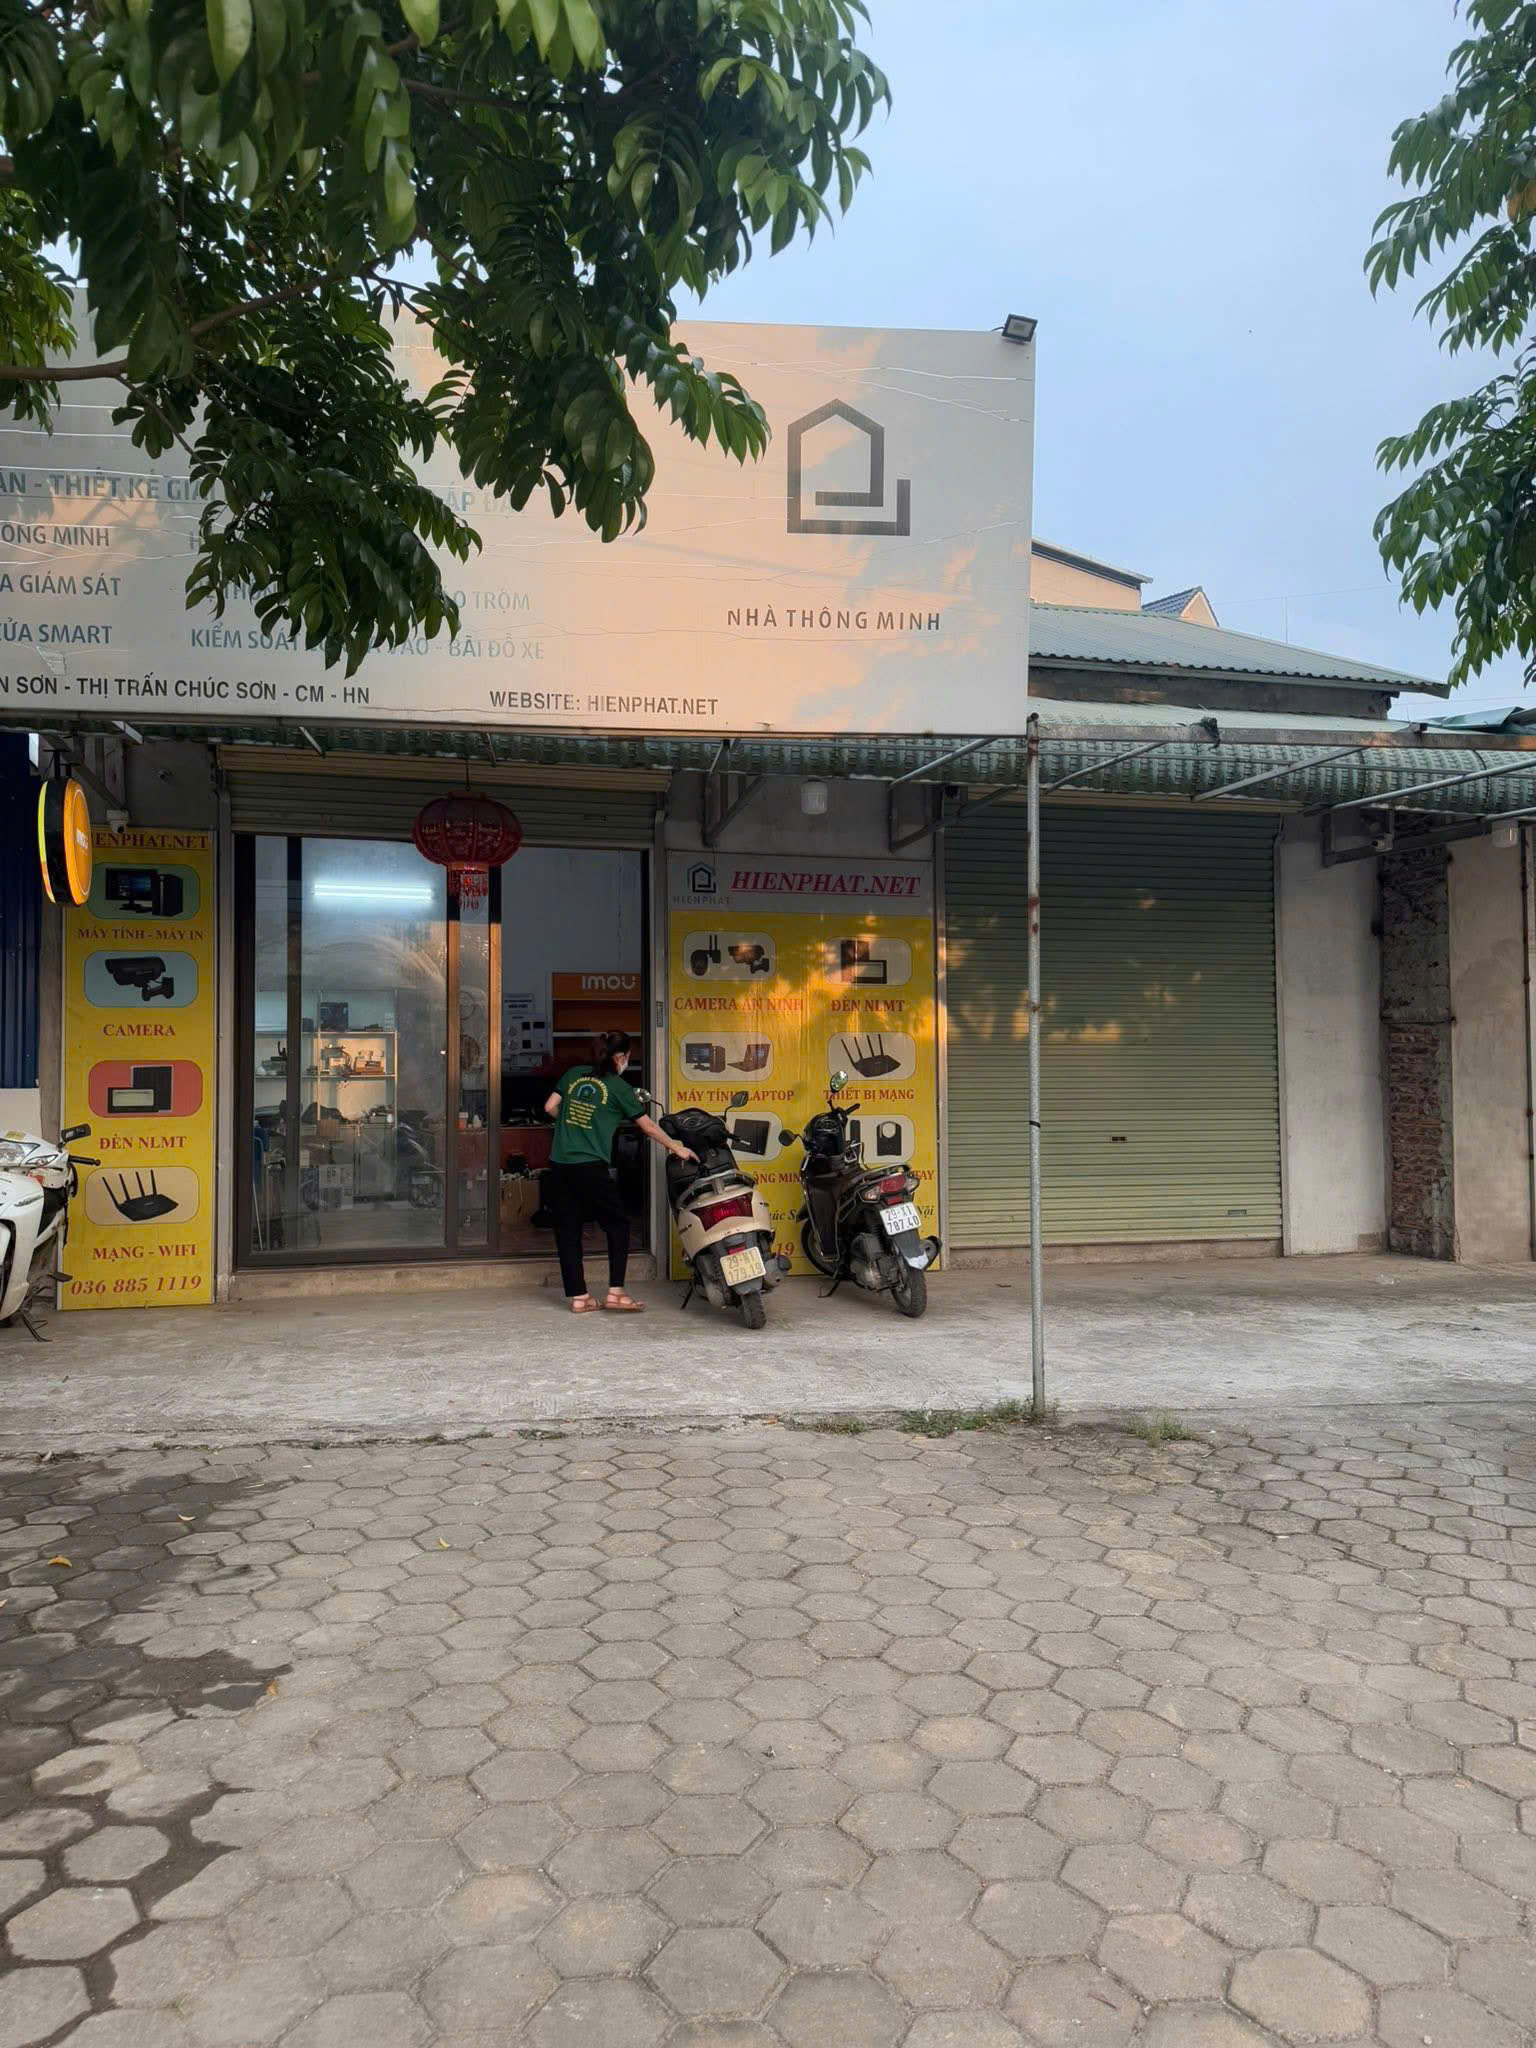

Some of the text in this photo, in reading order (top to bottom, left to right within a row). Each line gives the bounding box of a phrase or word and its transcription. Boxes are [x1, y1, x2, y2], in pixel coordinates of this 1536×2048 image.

[53, 526, 110, 547] MINH
[20, 571, 77, 595] GIÁM
[83, 573, 121, 596] SÁT
[472, 587, 530, 613] TRỘM
[727, 604, 940, 631] NHÀ THÔNG MINH
[0, 616, 112, 644] ỬA SMART
[191, 622, 241, 648] KIỂM
[521, 641, 544, 660] XE
[16, 674, 57, 695] SƠN
[77, 677, 109, 699] THỊ
[114, 672, 168, 697] TRẤN
[174, 677, 229, 699] CHÚC
[236, 680, 276, 700] SƠN
[295, 685, 324, 703] CM
[343, 687, 370, 705] HN
[489, 690, 718, 715] WEBSITE: HIENPHAT.NET
[92, 831, 208, 849] ENPHAT.NET
[731, 870, 921, 896] HIENPHAT.NET
[674, 997, 737, 1011] CAMERA
[767, 998, 804, 1011] NINH
[831, 997, 905, 1012] ĐÈN NLMT
[103, 1023, 176, 1037] CAMERA
[676, 1088, 704, 1102] MÁY
[748, 1090, 794, 1102] APTOP
[864, 1089, 876, 1102] BỊ
[880, 1088, 914, 1103] MẠNG
[100, 1133, 187, 1150] ĐÈN NLMT
[93, 1246, 144, 1263] MẠNG
[158, 1244, 197, 1257] WIFI
[71, 1275, 202, 1295] 036 885 1119
